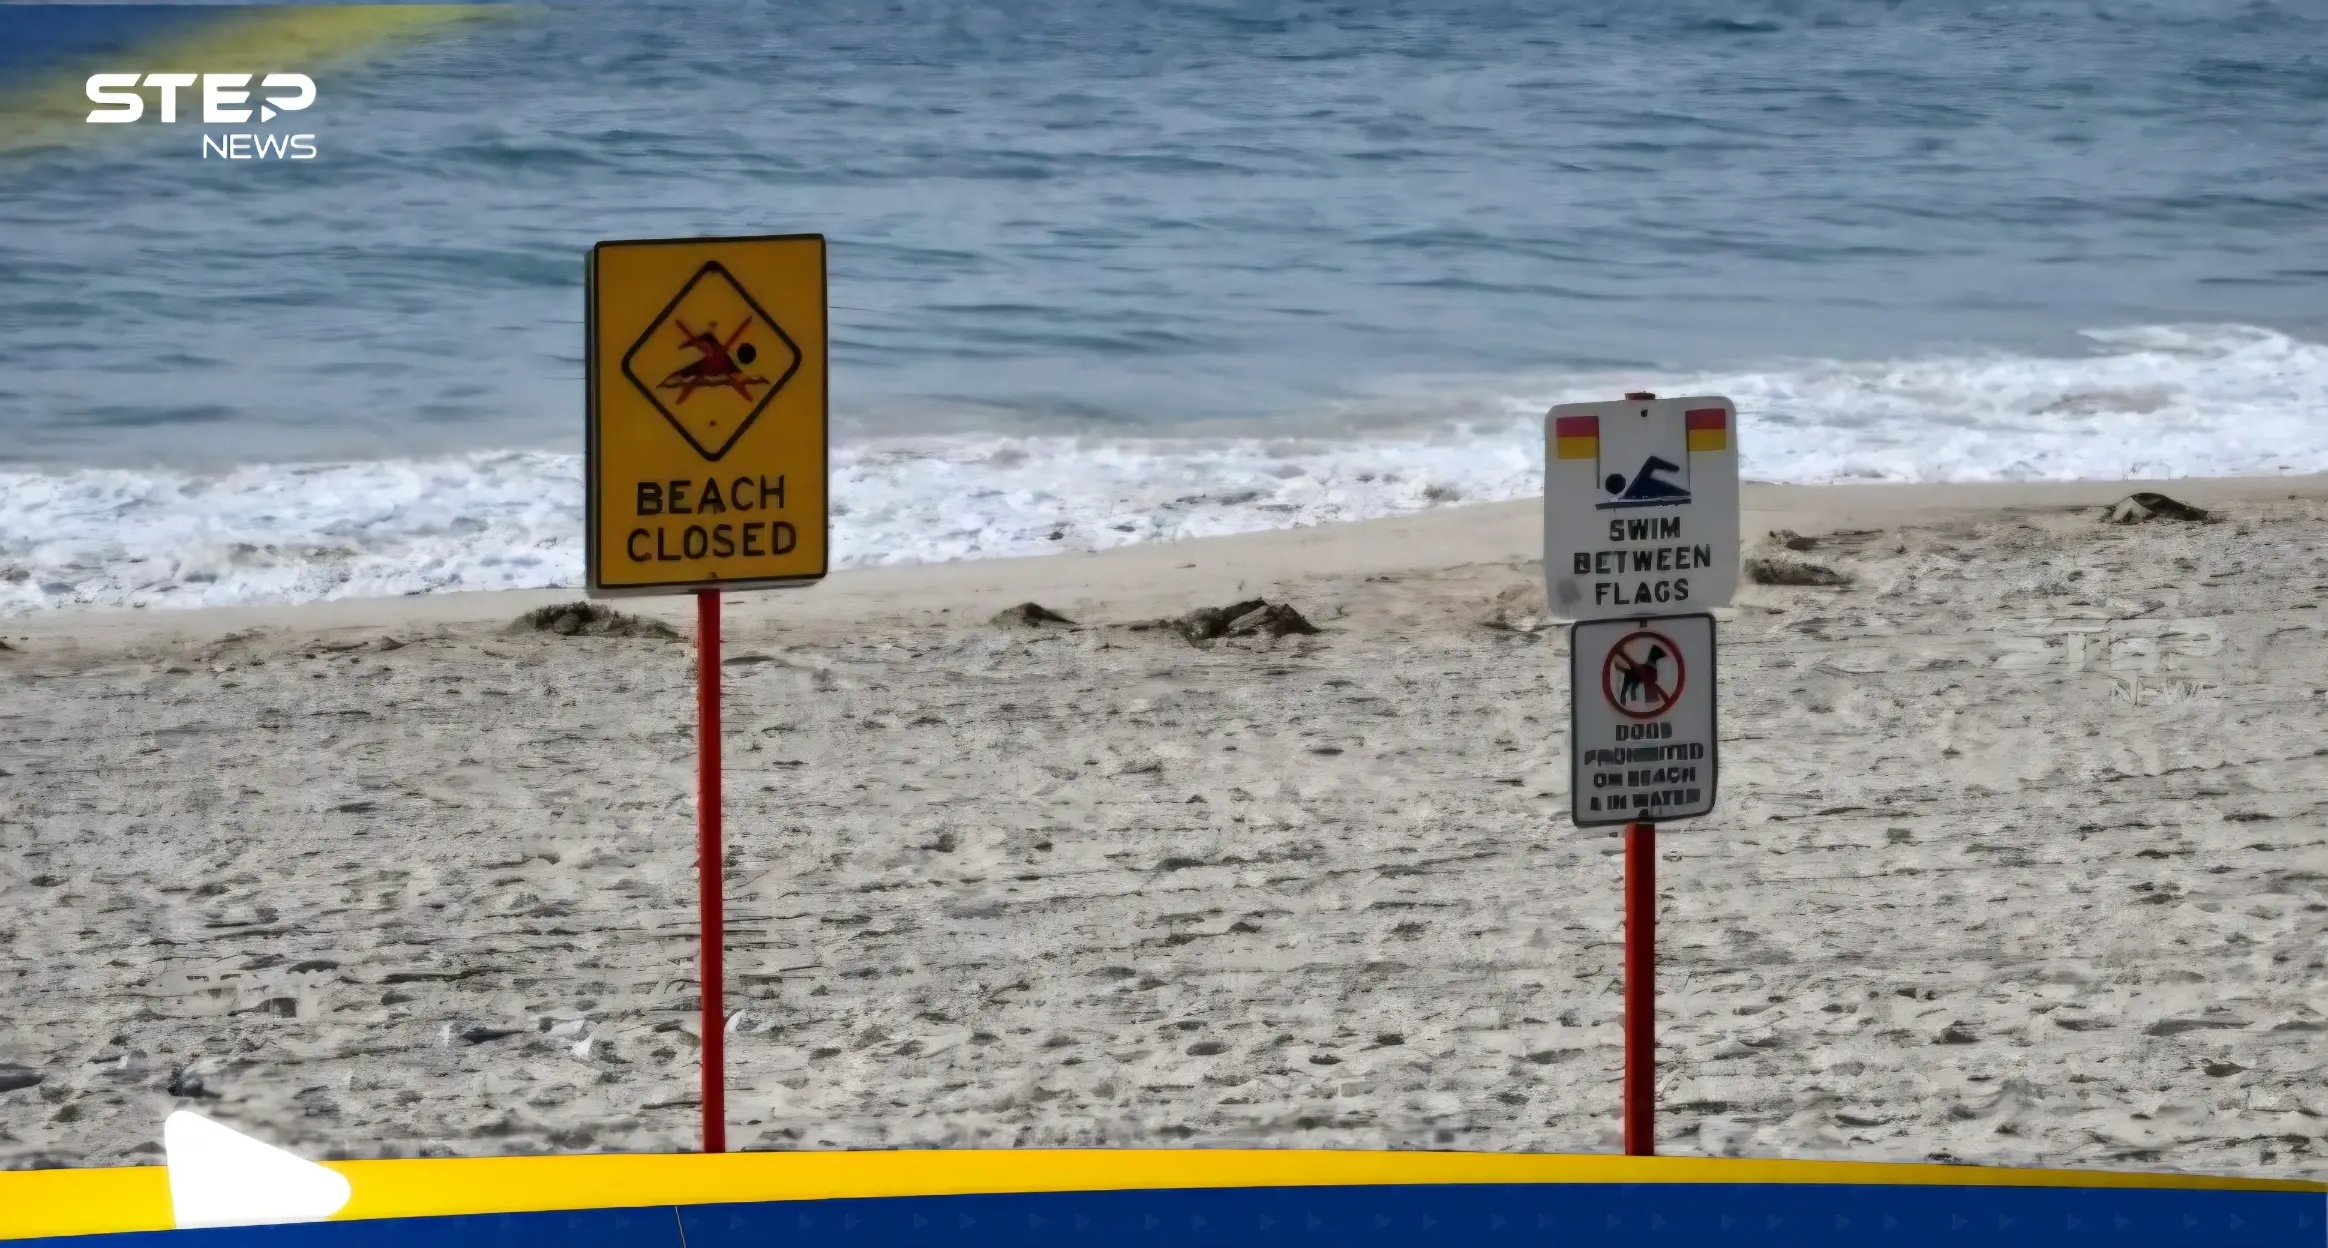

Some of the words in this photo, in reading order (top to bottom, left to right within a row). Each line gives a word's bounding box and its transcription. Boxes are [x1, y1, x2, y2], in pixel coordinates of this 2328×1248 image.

[637, 474, 785, 516] BEACH
[627, 521, 796, 562] CLOSED
[1609, 516, 1681, 542] SWIM
[1574, 543, 1711, 575] BETWEEN
[1595, 578, 1689, 605] FLAGS
[1584, 743, 1704, 766] PROTED
[1632, 789, 1700, 808] WAT
